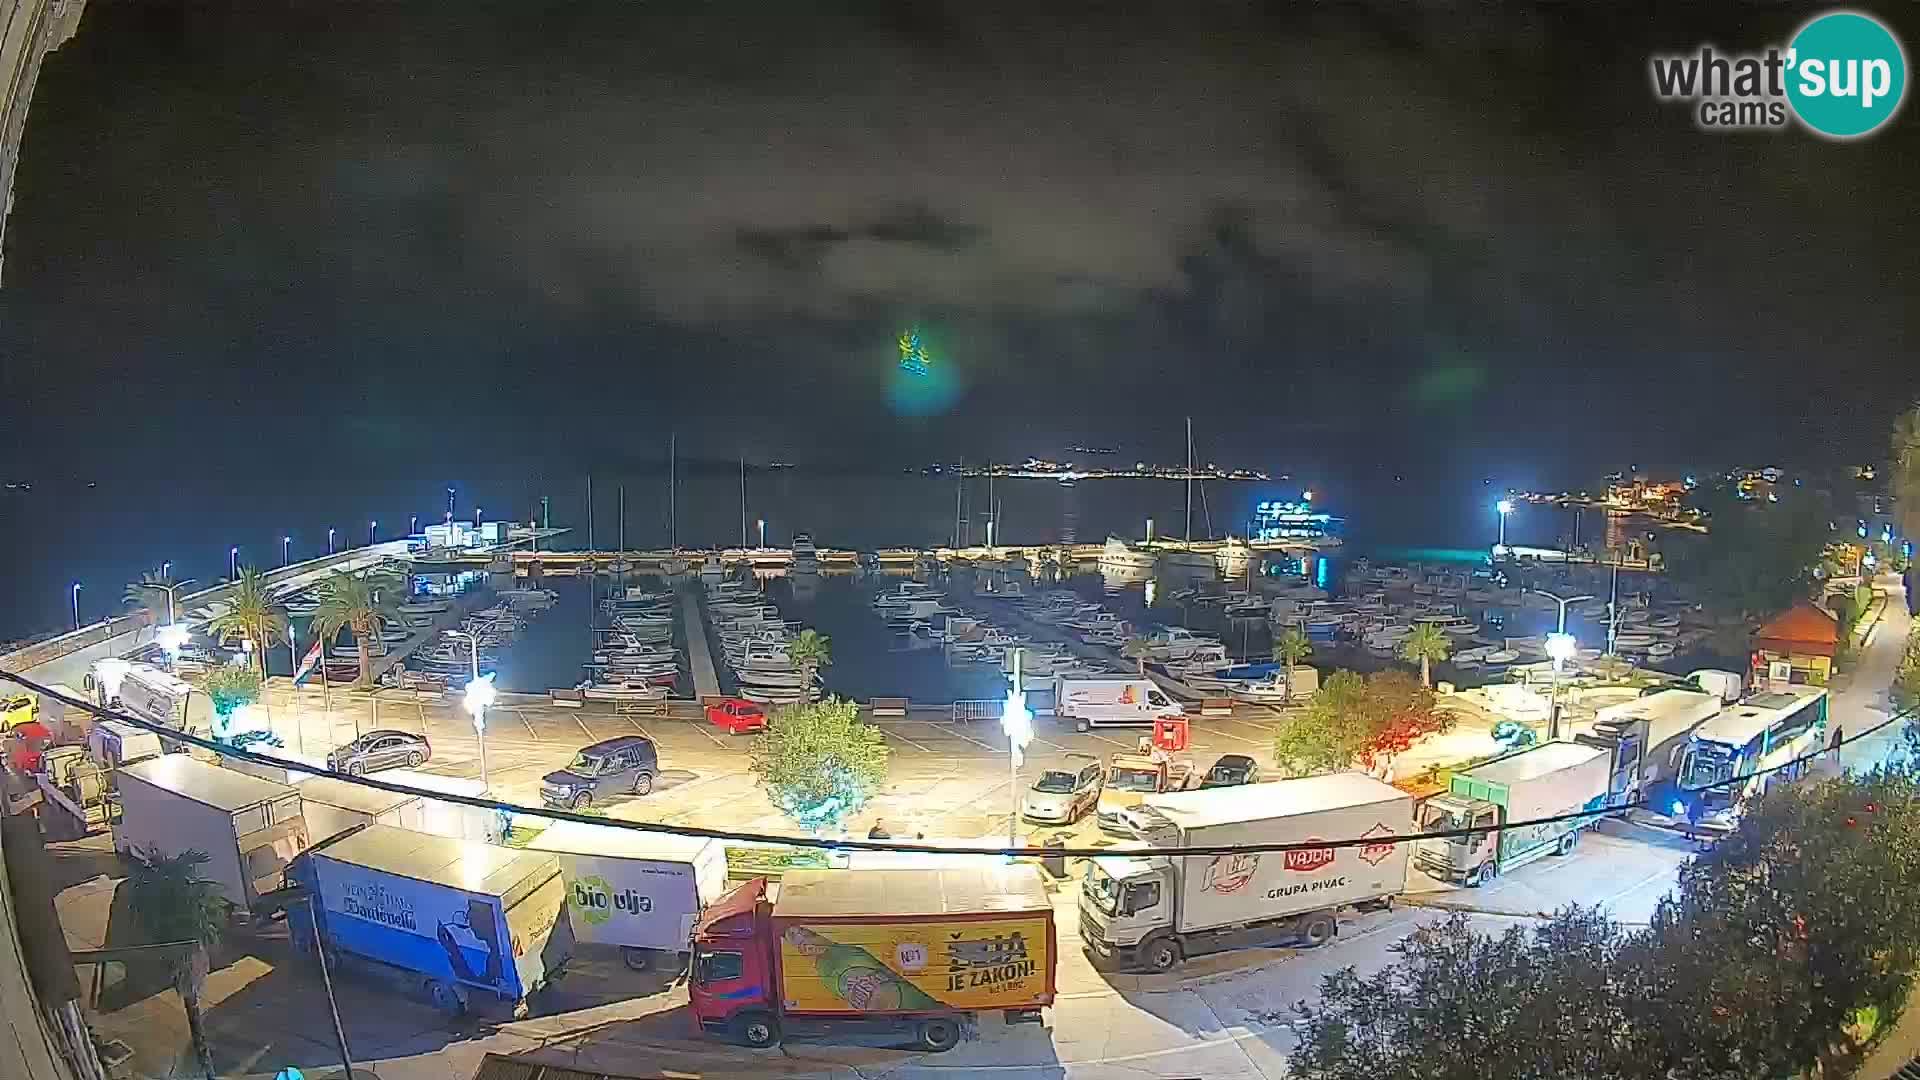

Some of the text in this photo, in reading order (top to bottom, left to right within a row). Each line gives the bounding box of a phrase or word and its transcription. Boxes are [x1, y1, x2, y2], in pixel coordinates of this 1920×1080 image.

[1287, 848, 1334, 868] VAJDA
[575, 883, 652, 915] bio ulja
[1267, 876, 1346, 899] GRUPA PIVAC
[945, 974, 965, 992] JE
[969, 959, 1035, 987] ZAKON!
